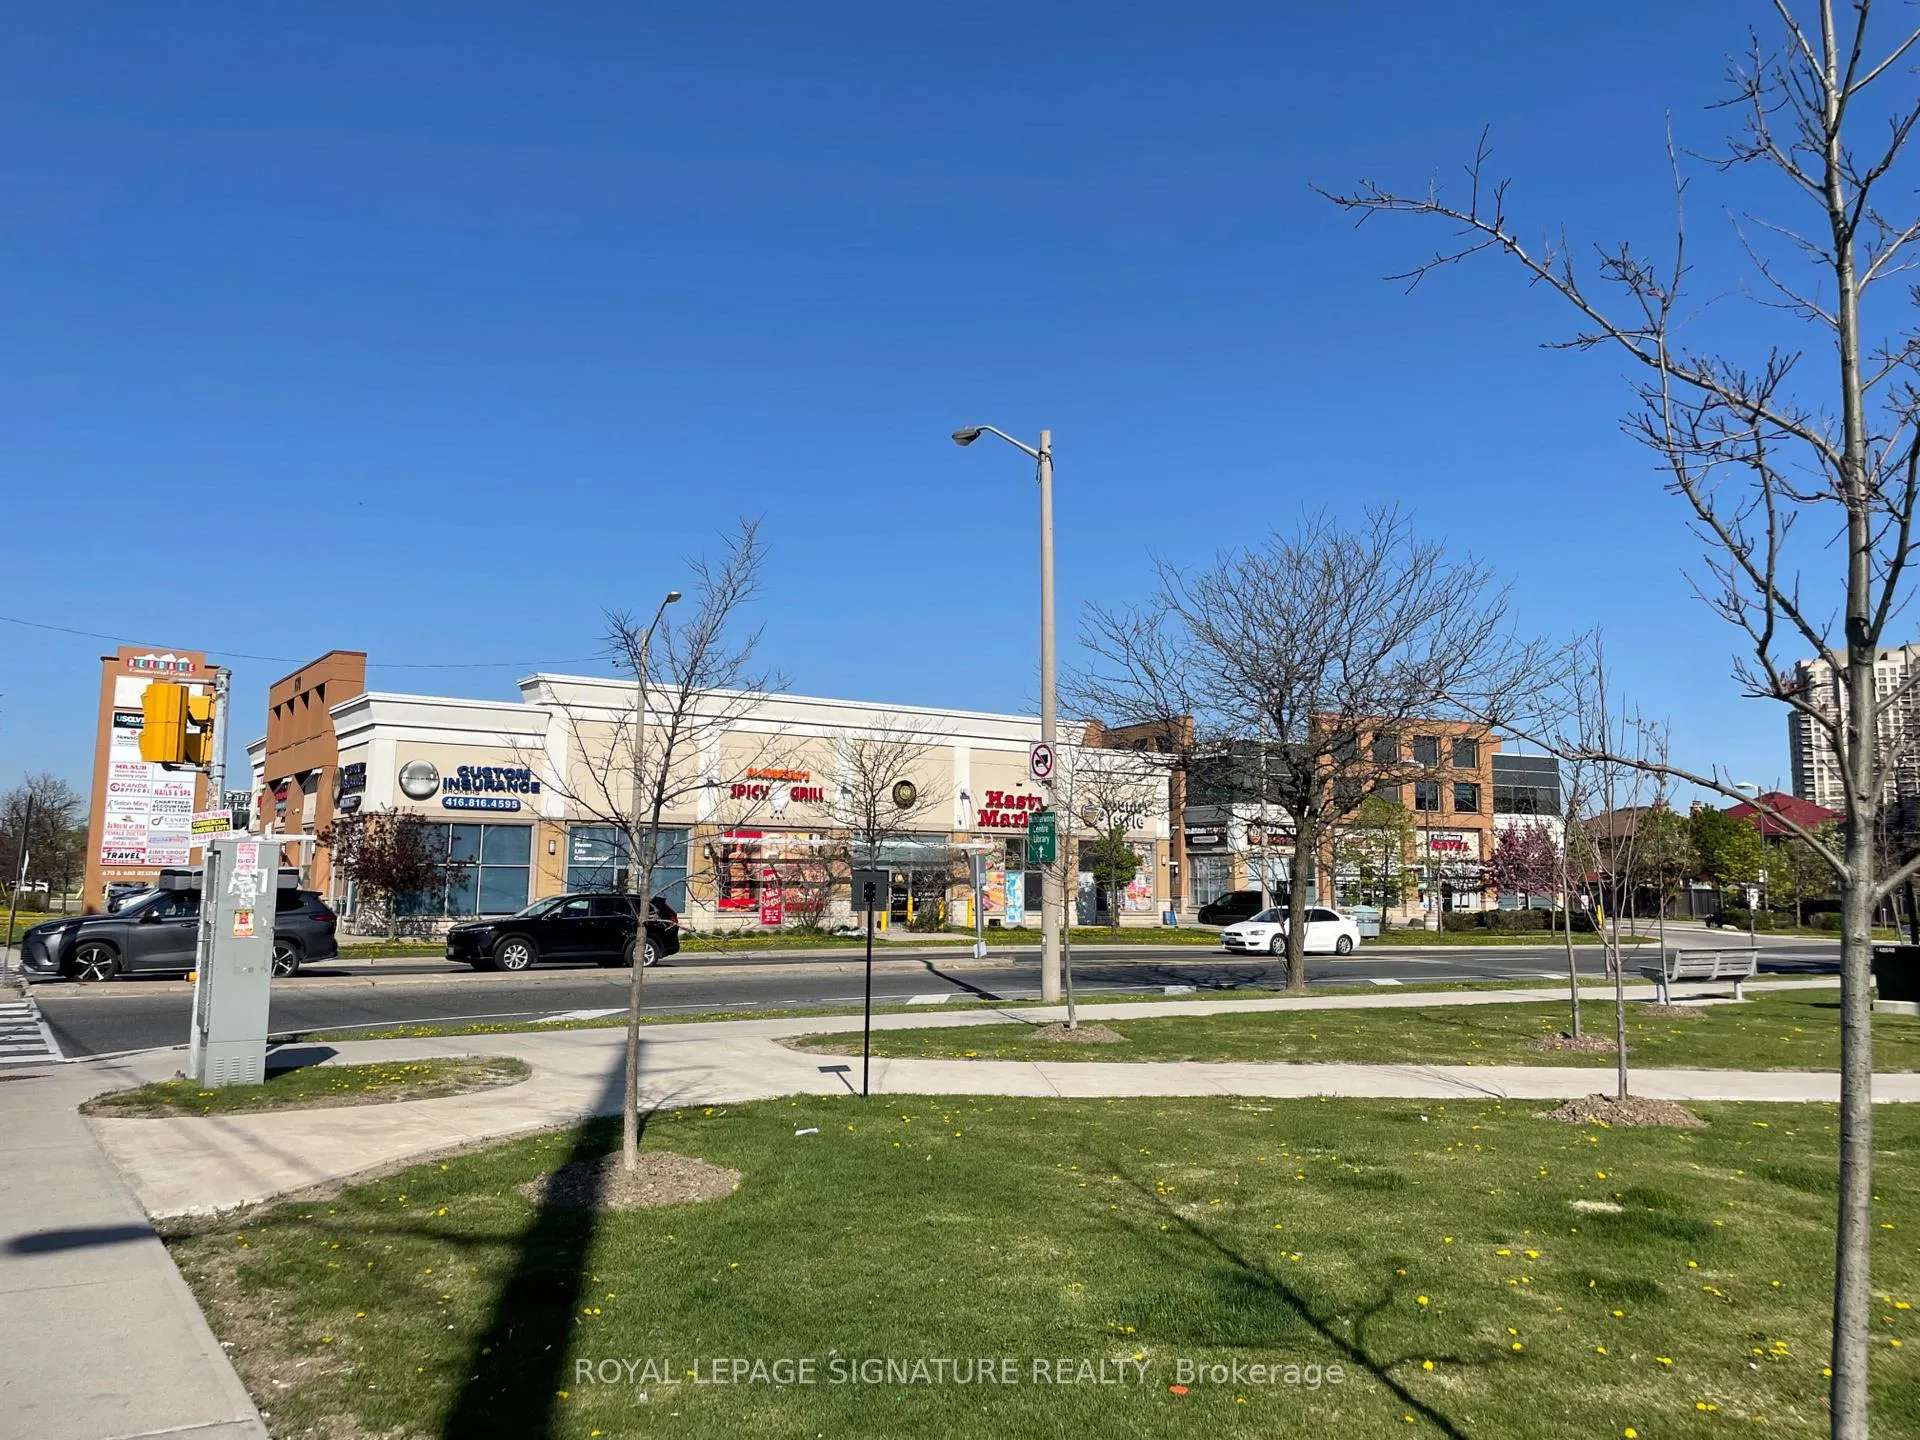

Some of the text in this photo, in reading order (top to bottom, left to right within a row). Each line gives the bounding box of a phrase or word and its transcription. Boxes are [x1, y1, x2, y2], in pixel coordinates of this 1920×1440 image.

[128, 658, 196, 672] REXDALE
[456, 765, 532, 782] CUSTOM
[442, 777, 541, 795] INSURANCE
[730, 783, 824, 802] SPICY GRILL
[445, 798, 518, 809] 416.816.4595
[985, 790, 1043, 812] Hasty
[1033, 824, 1049, 834] Centre
[1033, 834, 1050, 845] Library
